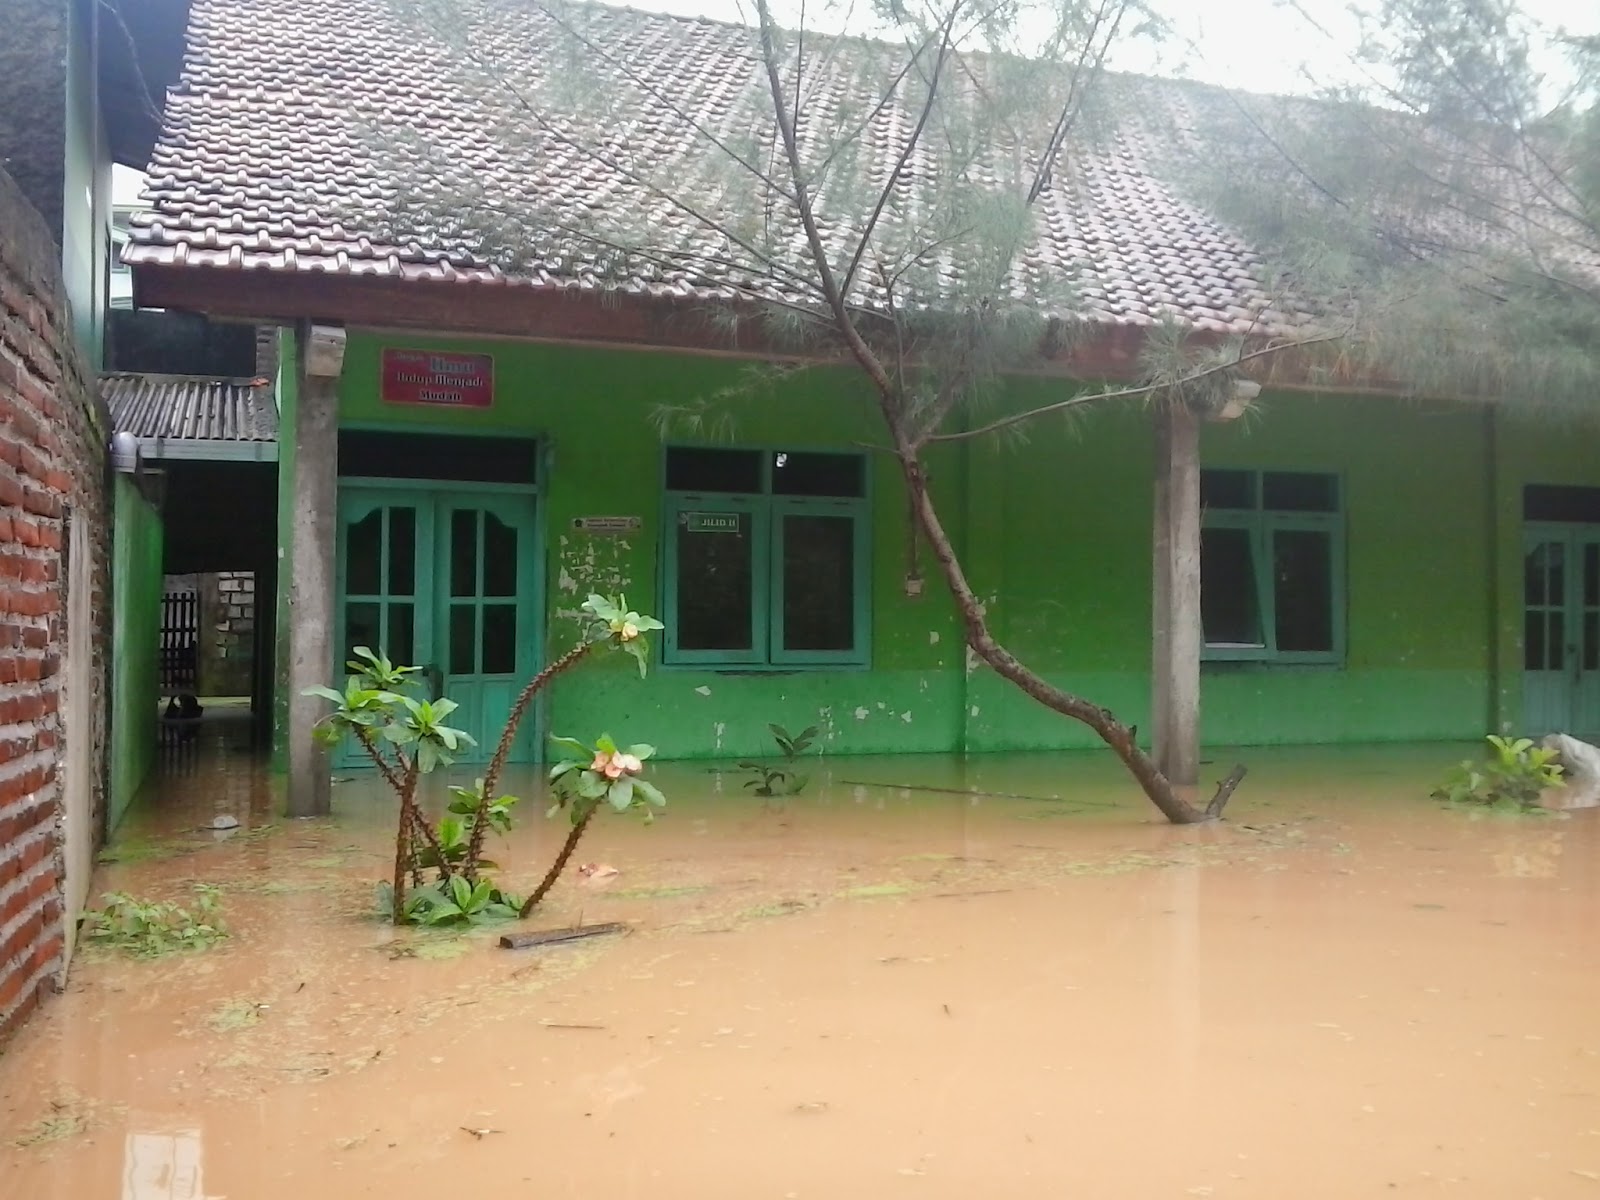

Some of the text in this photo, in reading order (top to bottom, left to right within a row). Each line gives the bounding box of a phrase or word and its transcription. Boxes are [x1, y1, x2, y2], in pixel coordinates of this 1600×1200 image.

[397, 371, 483, 388] Hidup Menjadi
[419, 388, 462, 401] Mudah
[701, 518, 726, 526] JILID
